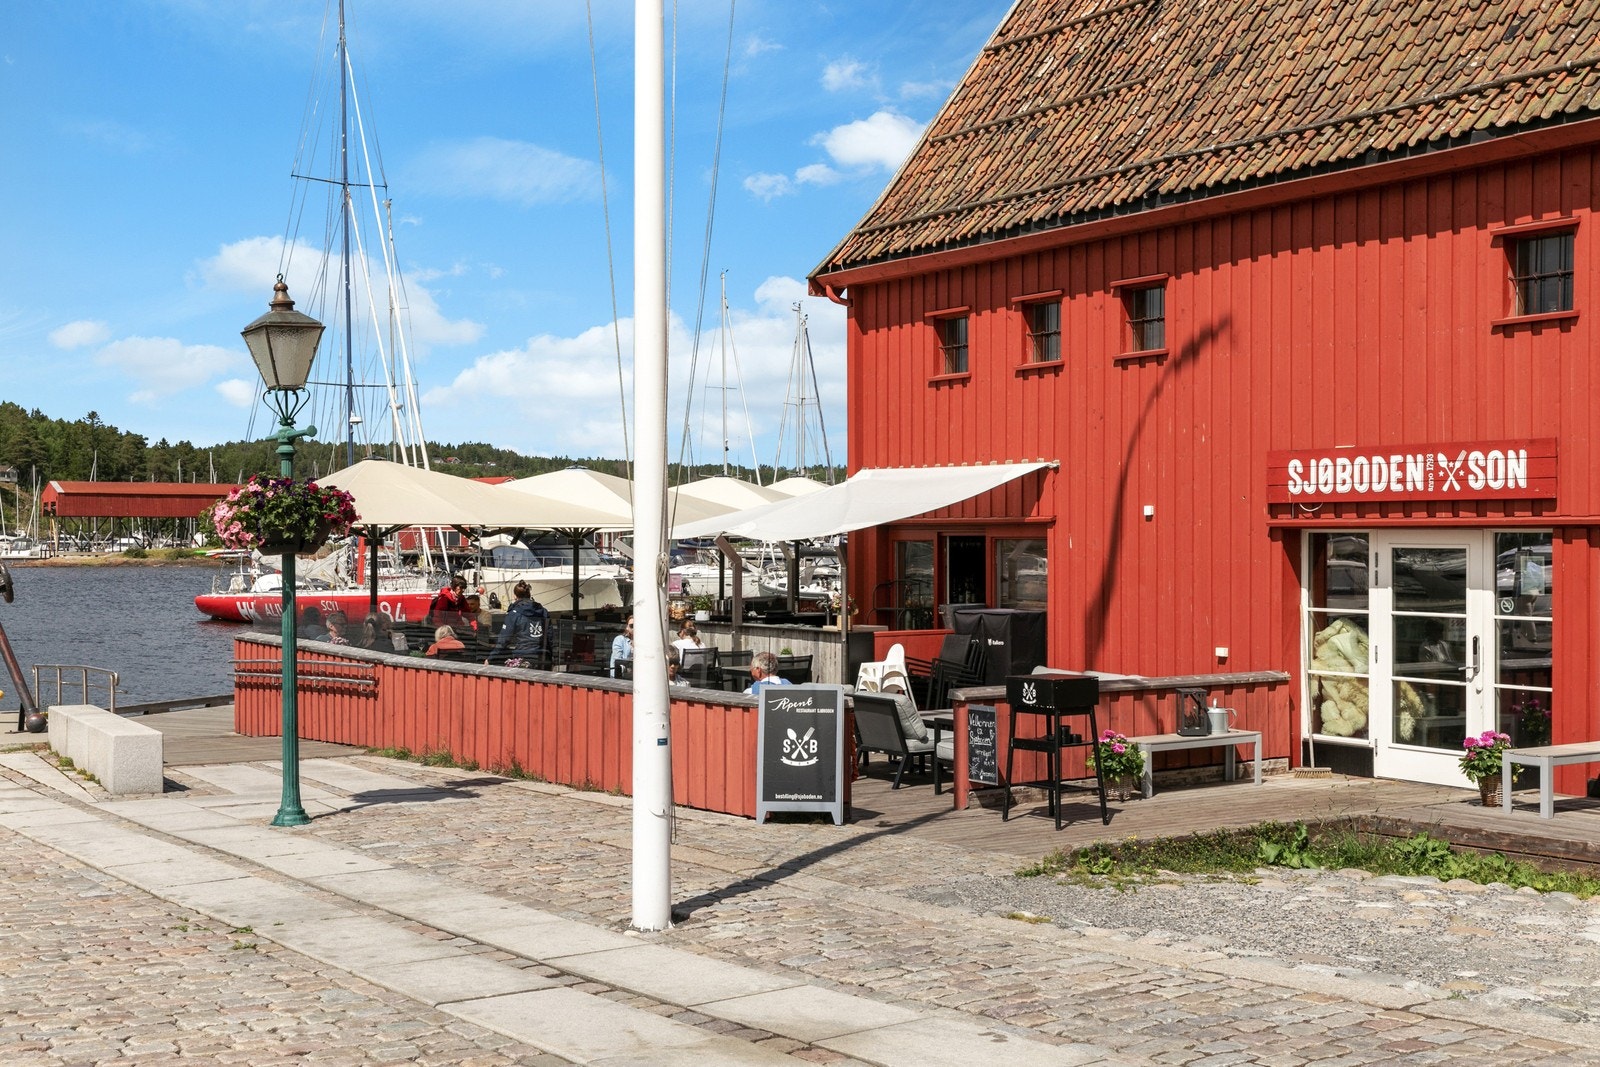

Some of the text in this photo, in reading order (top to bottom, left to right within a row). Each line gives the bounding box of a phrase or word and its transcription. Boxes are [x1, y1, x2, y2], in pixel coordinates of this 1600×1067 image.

[1288, 449, 1527, 495] SJØBODEN SON
[783, 739, 818, 753] S B
